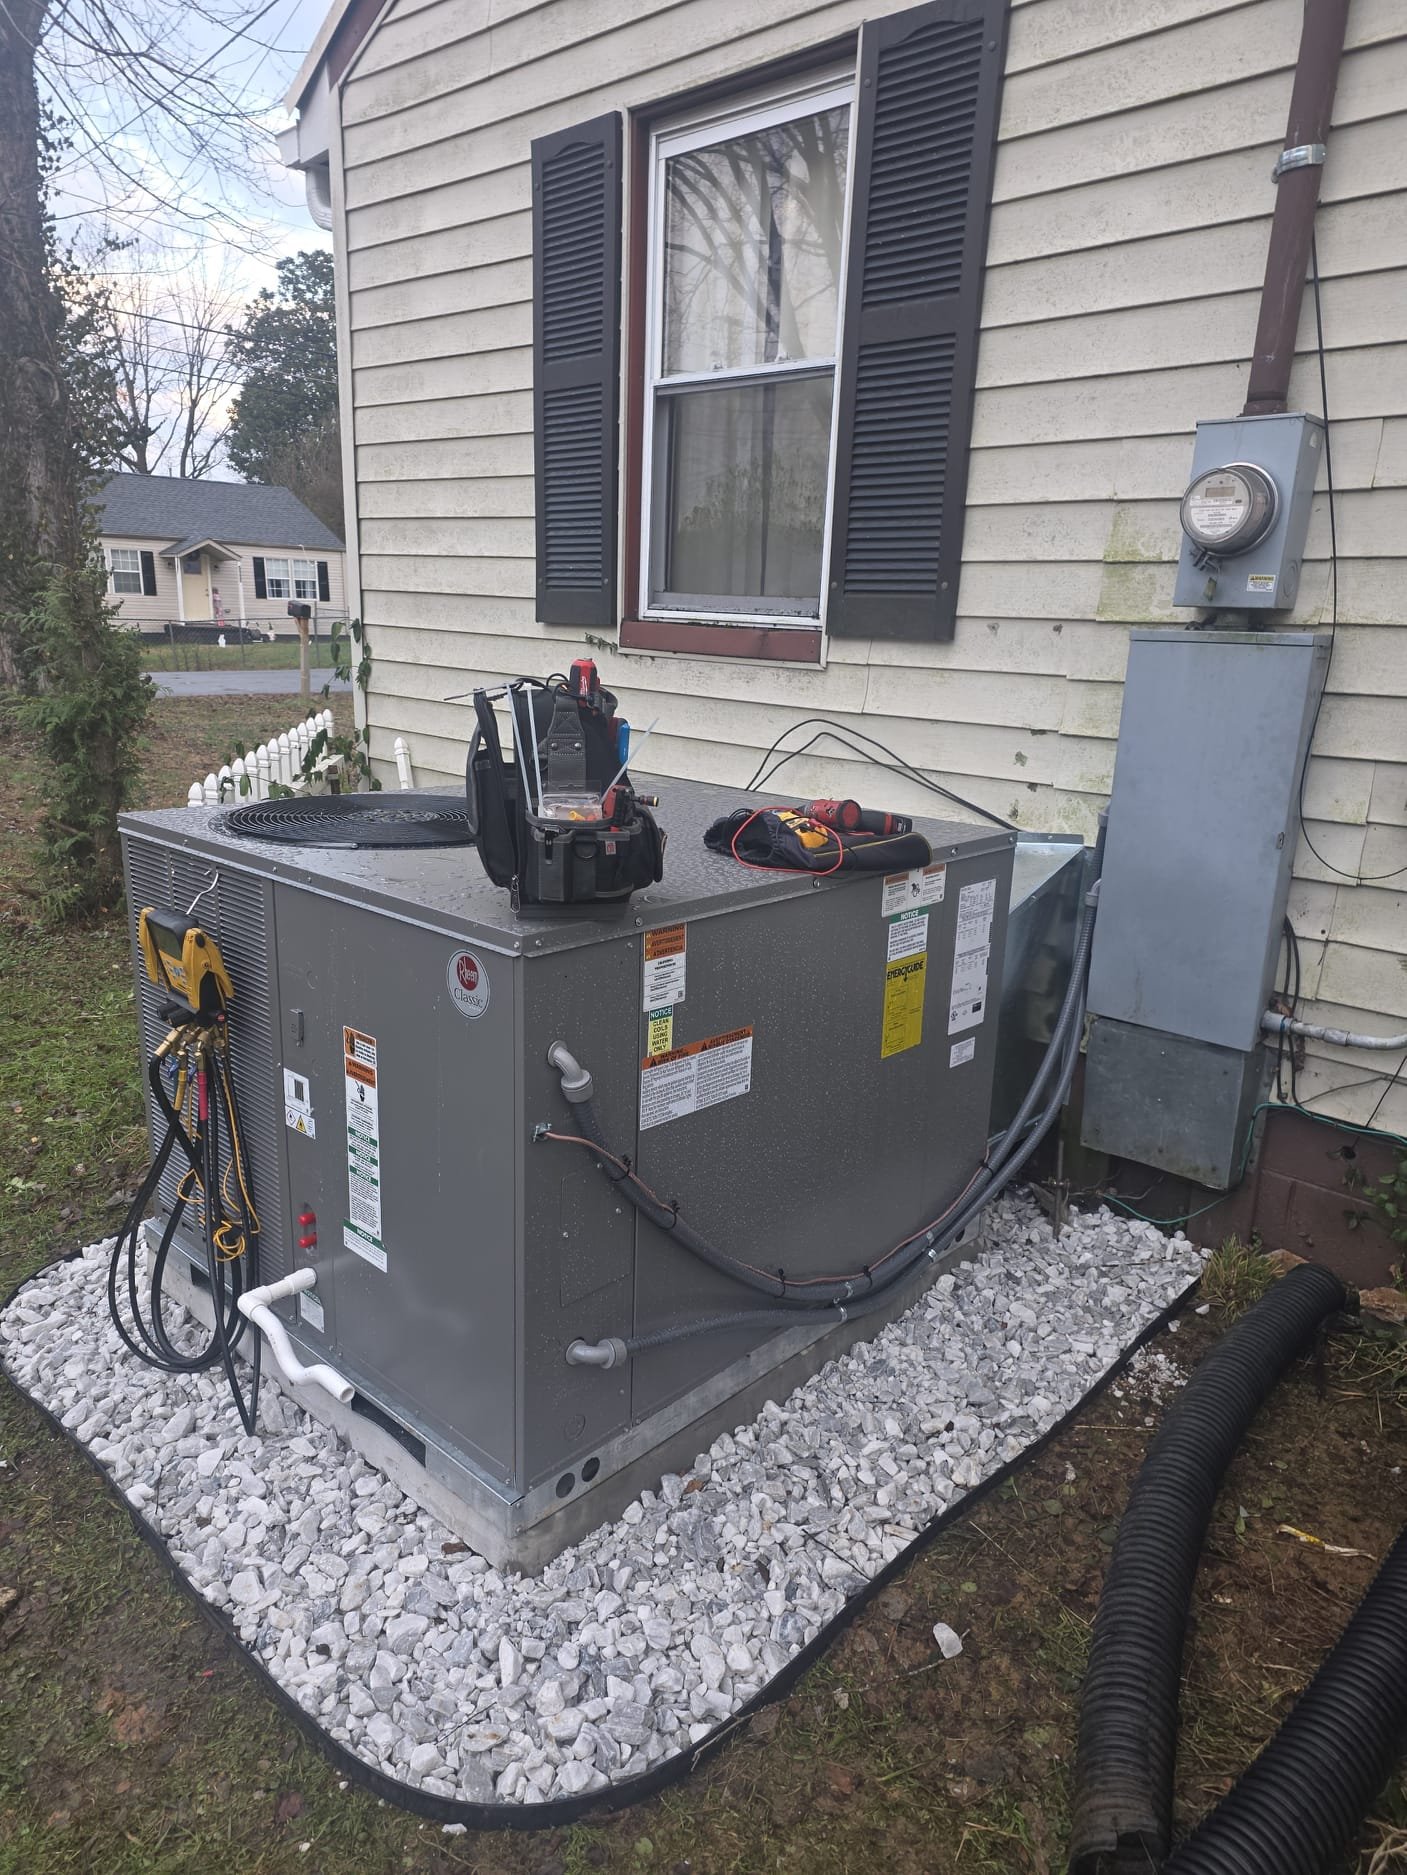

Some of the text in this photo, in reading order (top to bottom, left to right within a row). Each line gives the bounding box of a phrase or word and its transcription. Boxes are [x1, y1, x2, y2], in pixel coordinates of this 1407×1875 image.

[901, 909, 919, 920] NOTICE
[651, 923, 685, 937] WARNING
[458, 956, 478, 985] Rheem
[454, 987, 483, 1008] Classic
[650, 1007, 672, 1020] NOTICE
[652, 1018, 669, 1027] CLEAN
[653, 1024, 668, 1033] COILS
[651, 1037, 669, 1046] WATER
[652, 1031, 668, 1040] USING
[653, 1044, 667, 1053] ONLY
[355, 1130, 370, 1143] NOTICE
[355, 1149, 371, 1162] NOTICE
[356, 1169, 371, 1182] NOTICE
[356, 1227, 373, 1243] NOTICE
